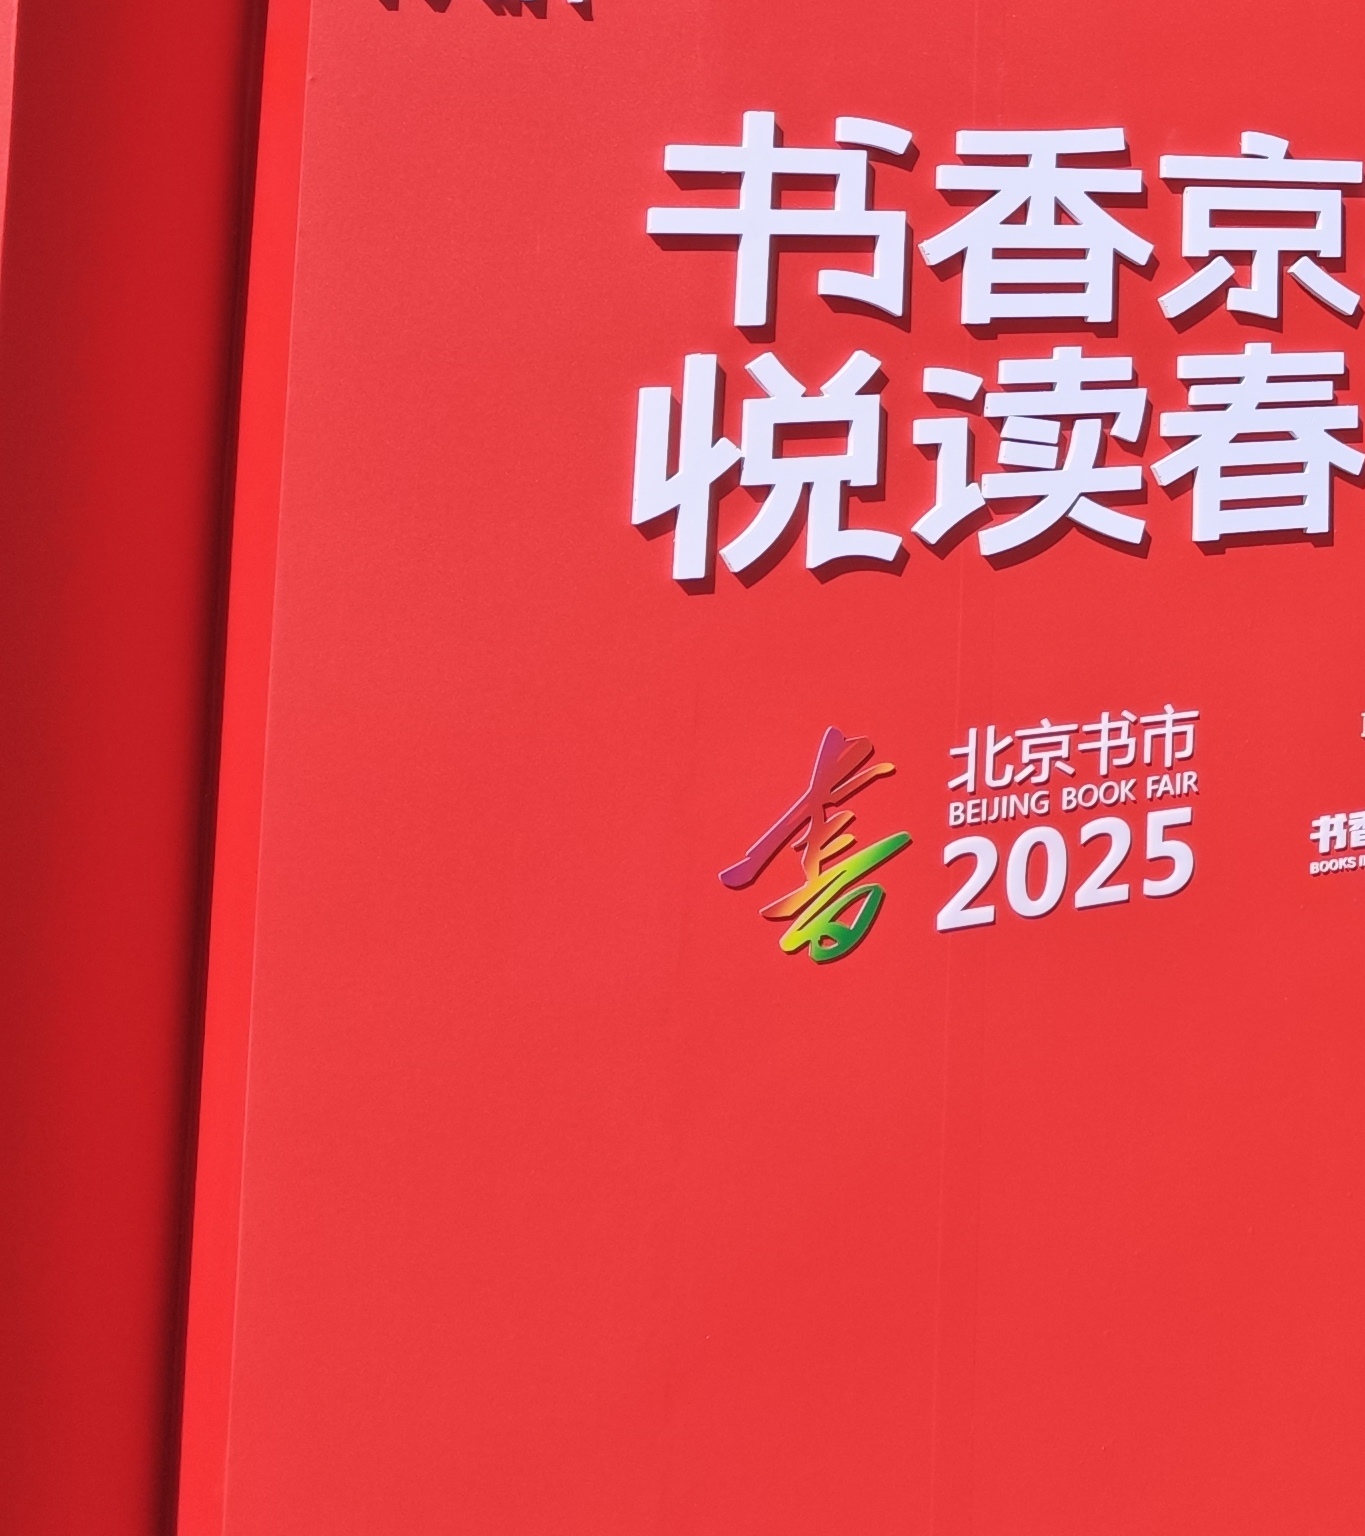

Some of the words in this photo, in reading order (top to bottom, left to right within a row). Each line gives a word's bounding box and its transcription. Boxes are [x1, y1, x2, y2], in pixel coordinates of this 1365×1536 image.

[947, 703, 1200, 793] 北京书市
[948, 790, 1050, 827] BEIJING
[1061, 778, 1137, 811] BOOK
[1146, 770, 1199, 799] FAIR
[936, 806, 1195, 931] 2025
[1309, 856, 1357, 875] BOOKS
